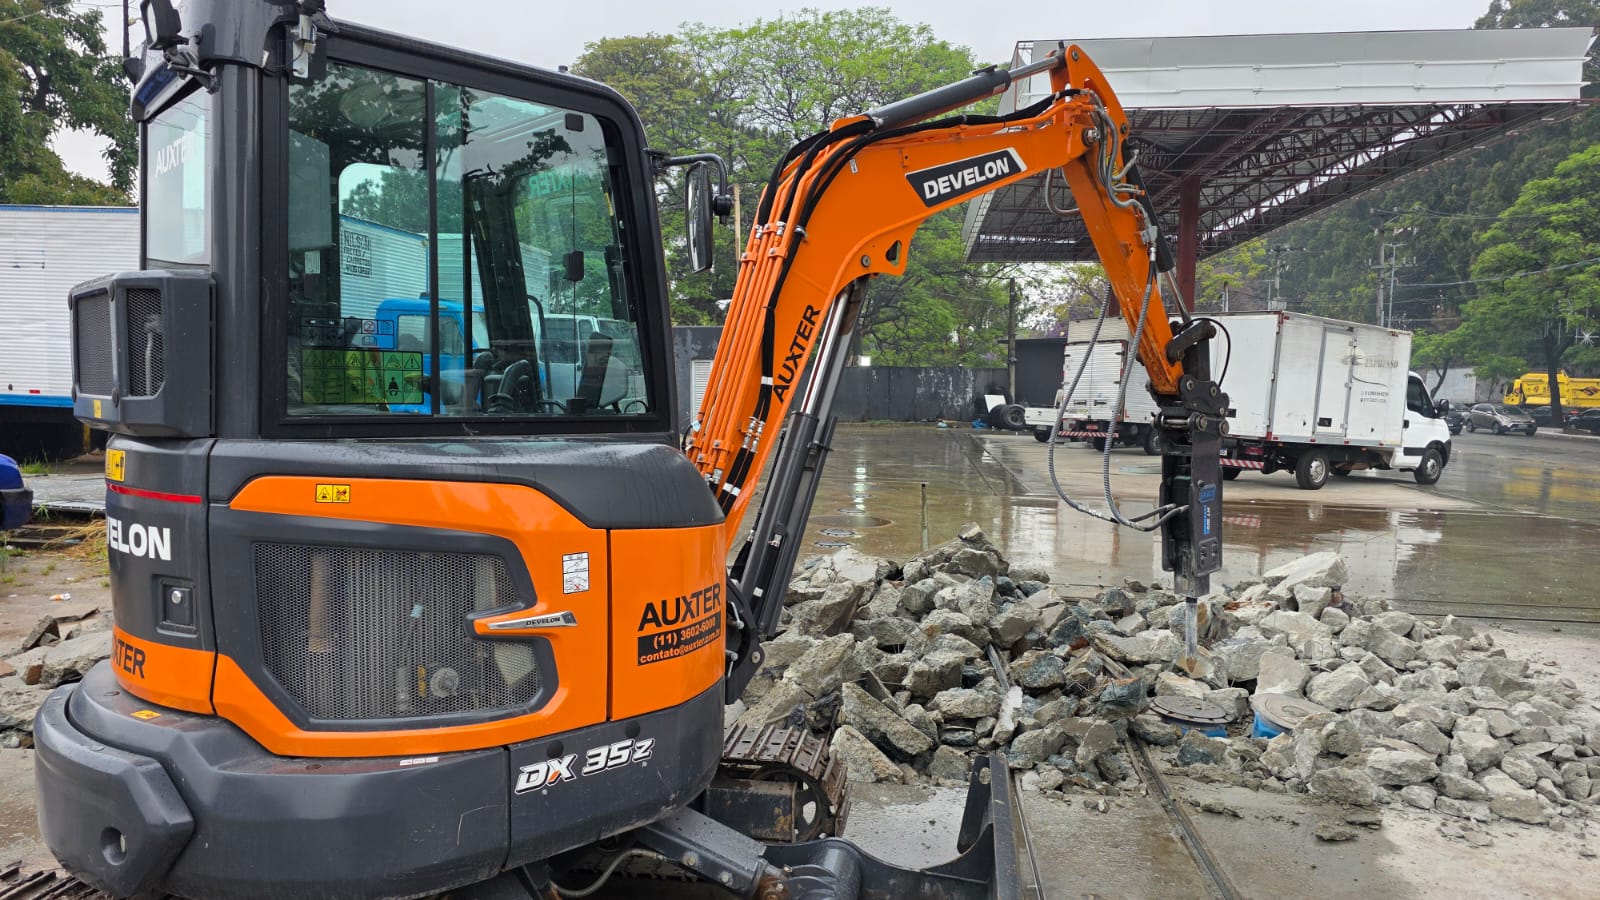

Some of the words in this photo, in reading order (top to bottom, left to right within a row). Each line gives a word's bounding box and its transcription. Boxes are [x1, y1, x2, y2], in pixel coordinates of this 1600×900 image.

[923, 157, 1010, 199] DEVELON
[773, 304, 821, 404] AUXTER
[107, 515, 171, 561] ELON
[526, 616, 561, 626] DEVELON
[638, 582, 721, 632] AUXTER
[653, 632, 678, 649] (11)
[515, 754, 577, 794] DX
